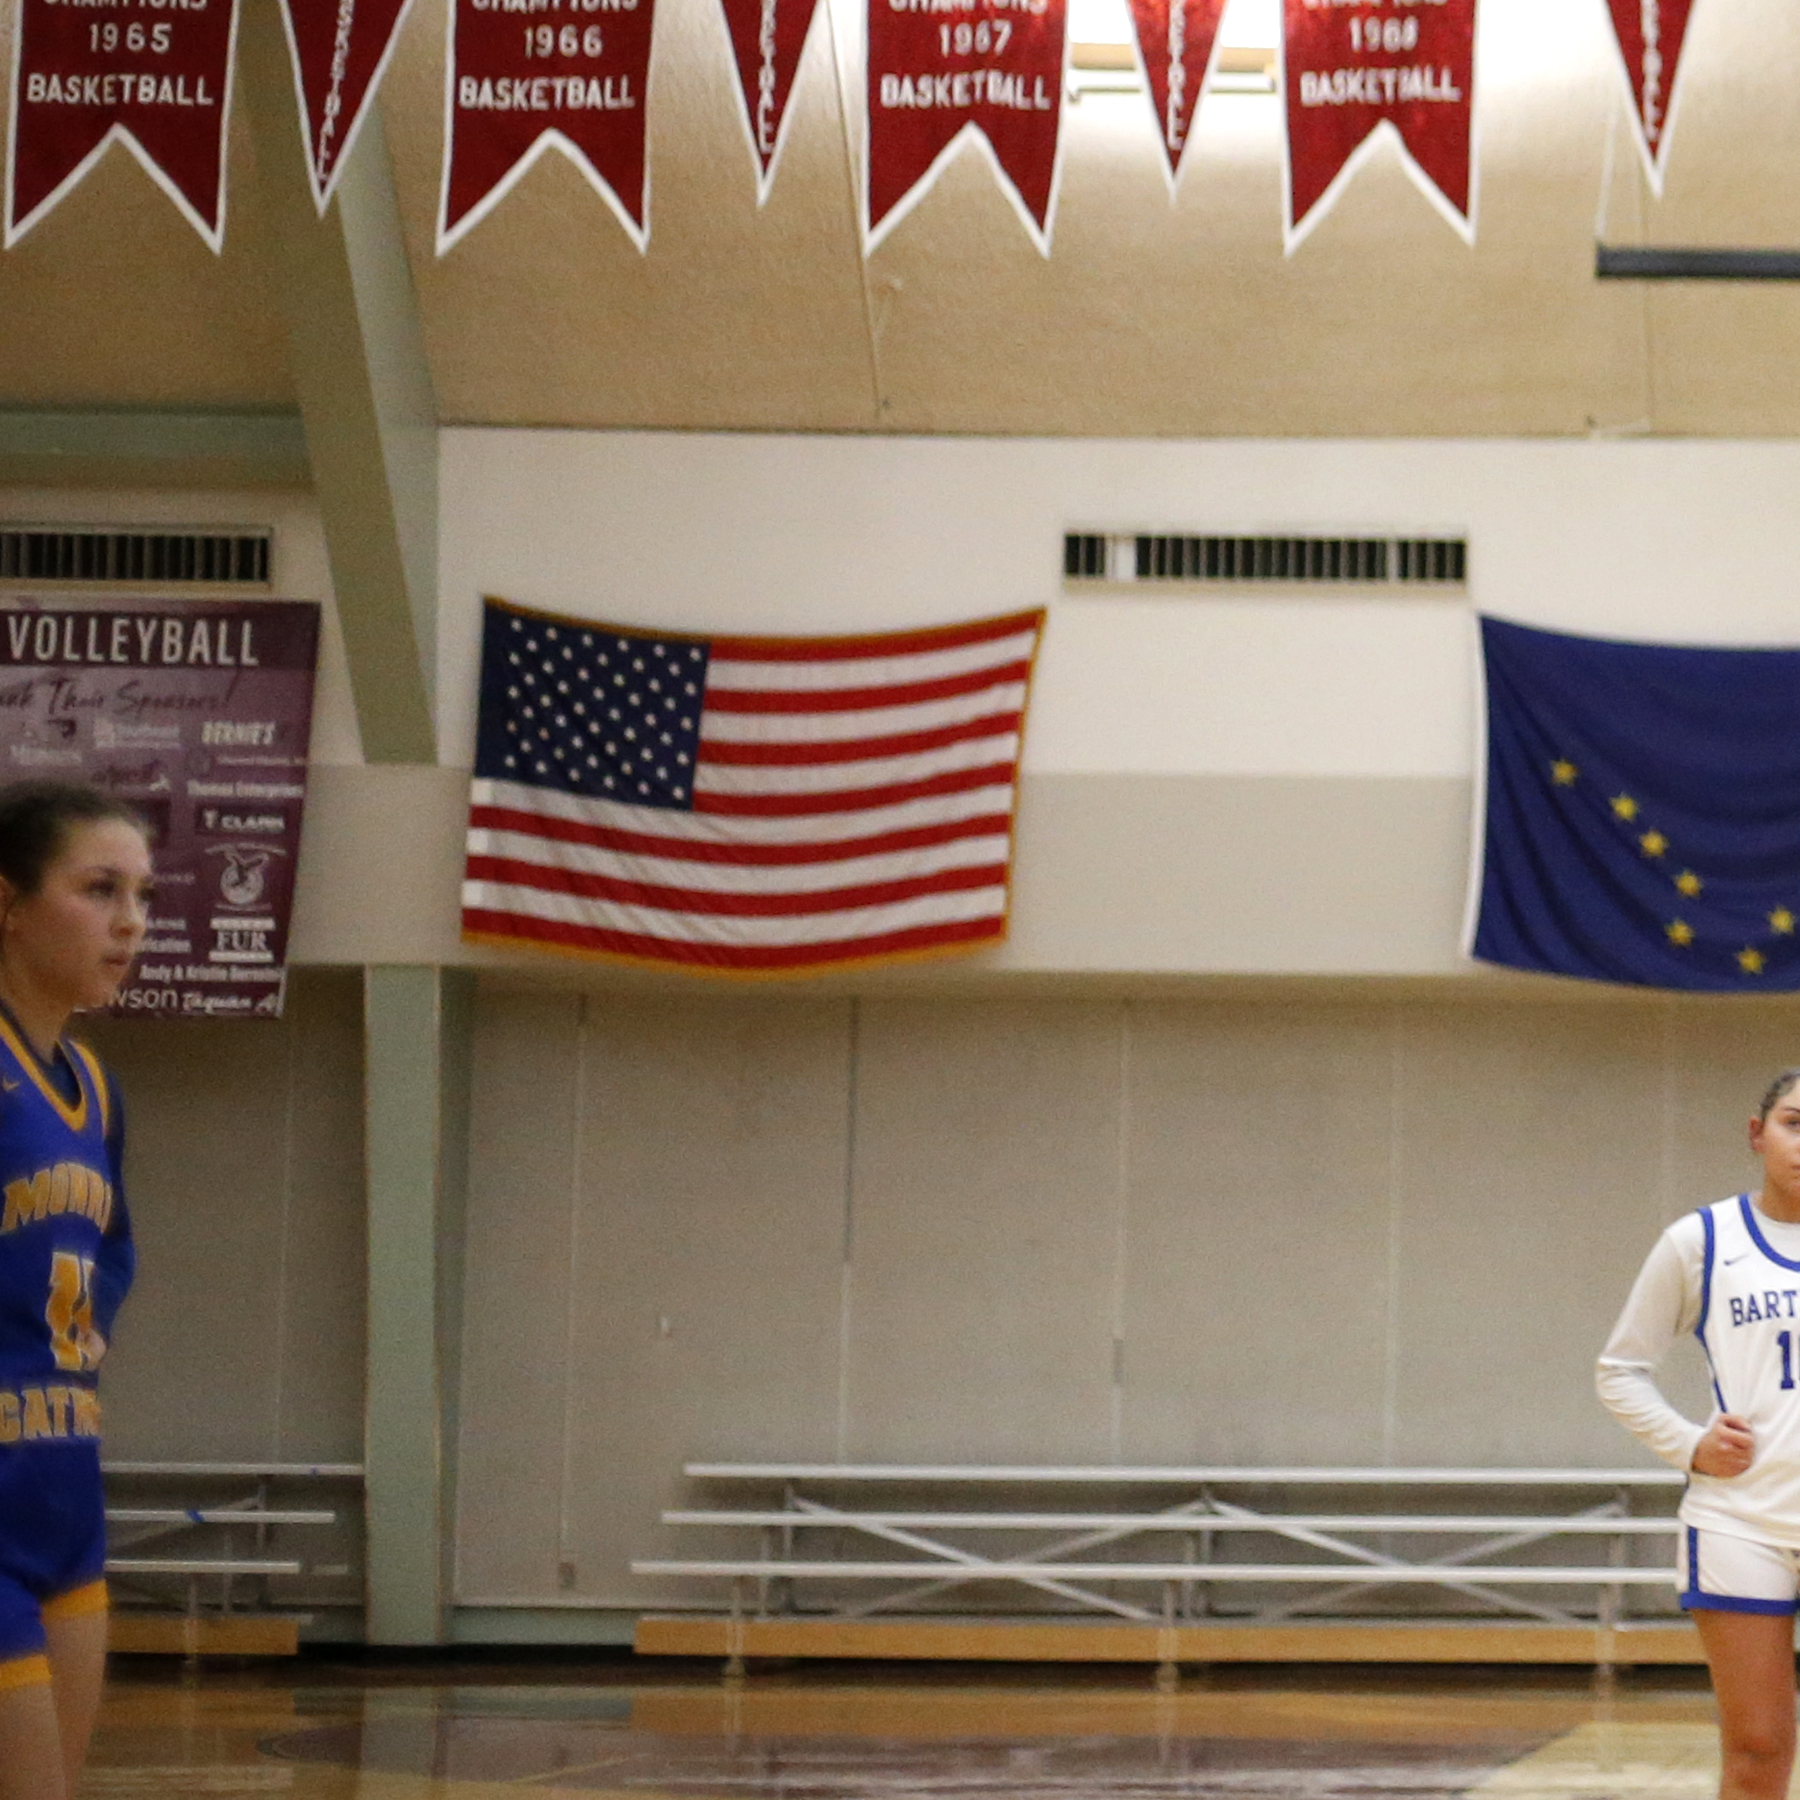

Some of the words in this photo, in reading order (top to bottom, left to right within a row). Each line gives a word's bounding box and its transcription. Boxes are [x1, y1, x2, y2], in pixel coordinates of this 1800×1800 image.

[88, 23, 171, 52] 1965
[523, 26, 603, 58] 1966
[937, 21, 1012, 54] 1967
[27, 74, 214, 107] BASKETBALL
[459, 75, 635, 110] BASKETBALL
[880, 72, 1051, 110] BASKETBALL
[1300, 67, 1461, 104] BASKETBALL
[7, 615, 259, 666] VOLLEYBALL
